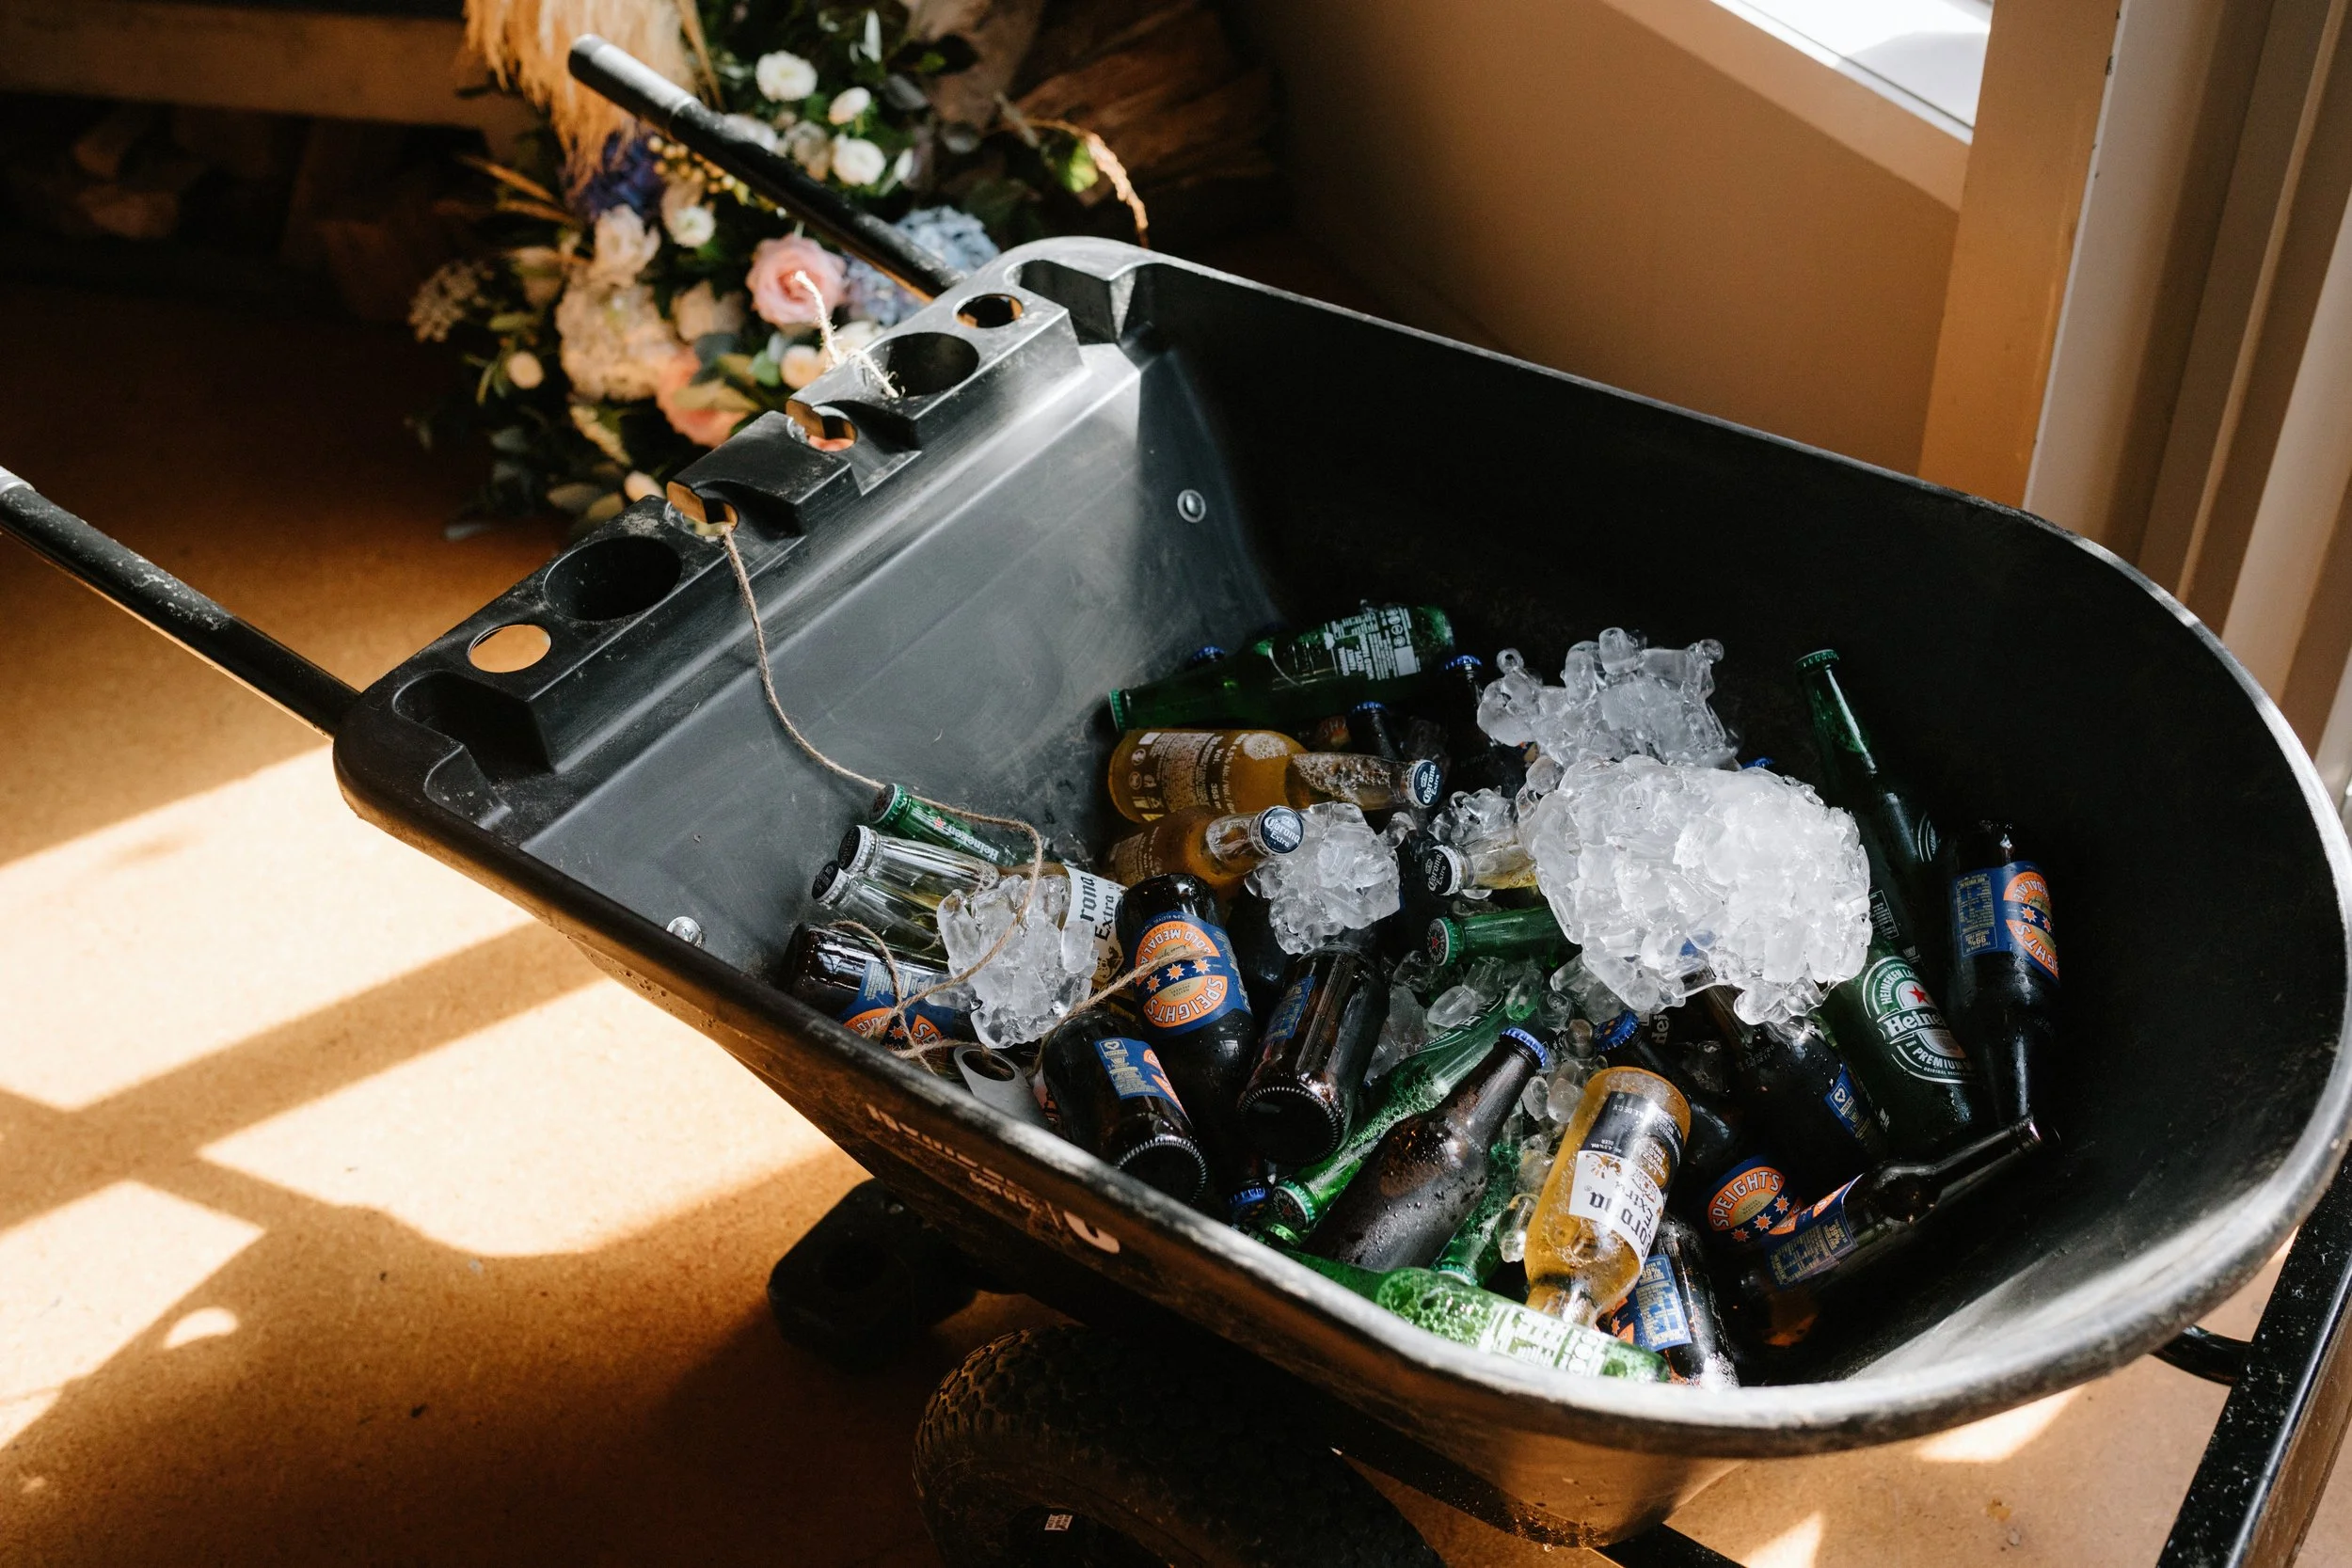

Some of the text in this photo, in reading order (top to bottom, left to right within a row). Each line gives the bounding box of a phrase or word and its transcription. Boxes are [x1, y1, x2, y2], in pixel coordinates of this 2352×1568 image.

[1210, 783, 1220, 800] 355
[1422, 764, 1436, 804] Corona
[1430, 774, 1440, 796] Extra
[946, 825, 1000, 862] Heineken
[1263, 816, 1300, 846] Corona
[1269, 830, 1290, 847] Extra
[1427, 852, 1444, 892] Corona
[1436, 865, 1447, 886] Extra
[1080, 876, 1096, 922] rona
[1144, 928, 1182, 954] MEDAL
[1967, 935, 1986, 946] 99%
[1146, 976, 1223, 1023] SPEIGHT'S
[1879, 969, 1905, 1006] HEINEKEN
[1883, 1010, 1947, 1037] Heine
[1711, 1170, 1780, 1229] SPEIGHT'S
